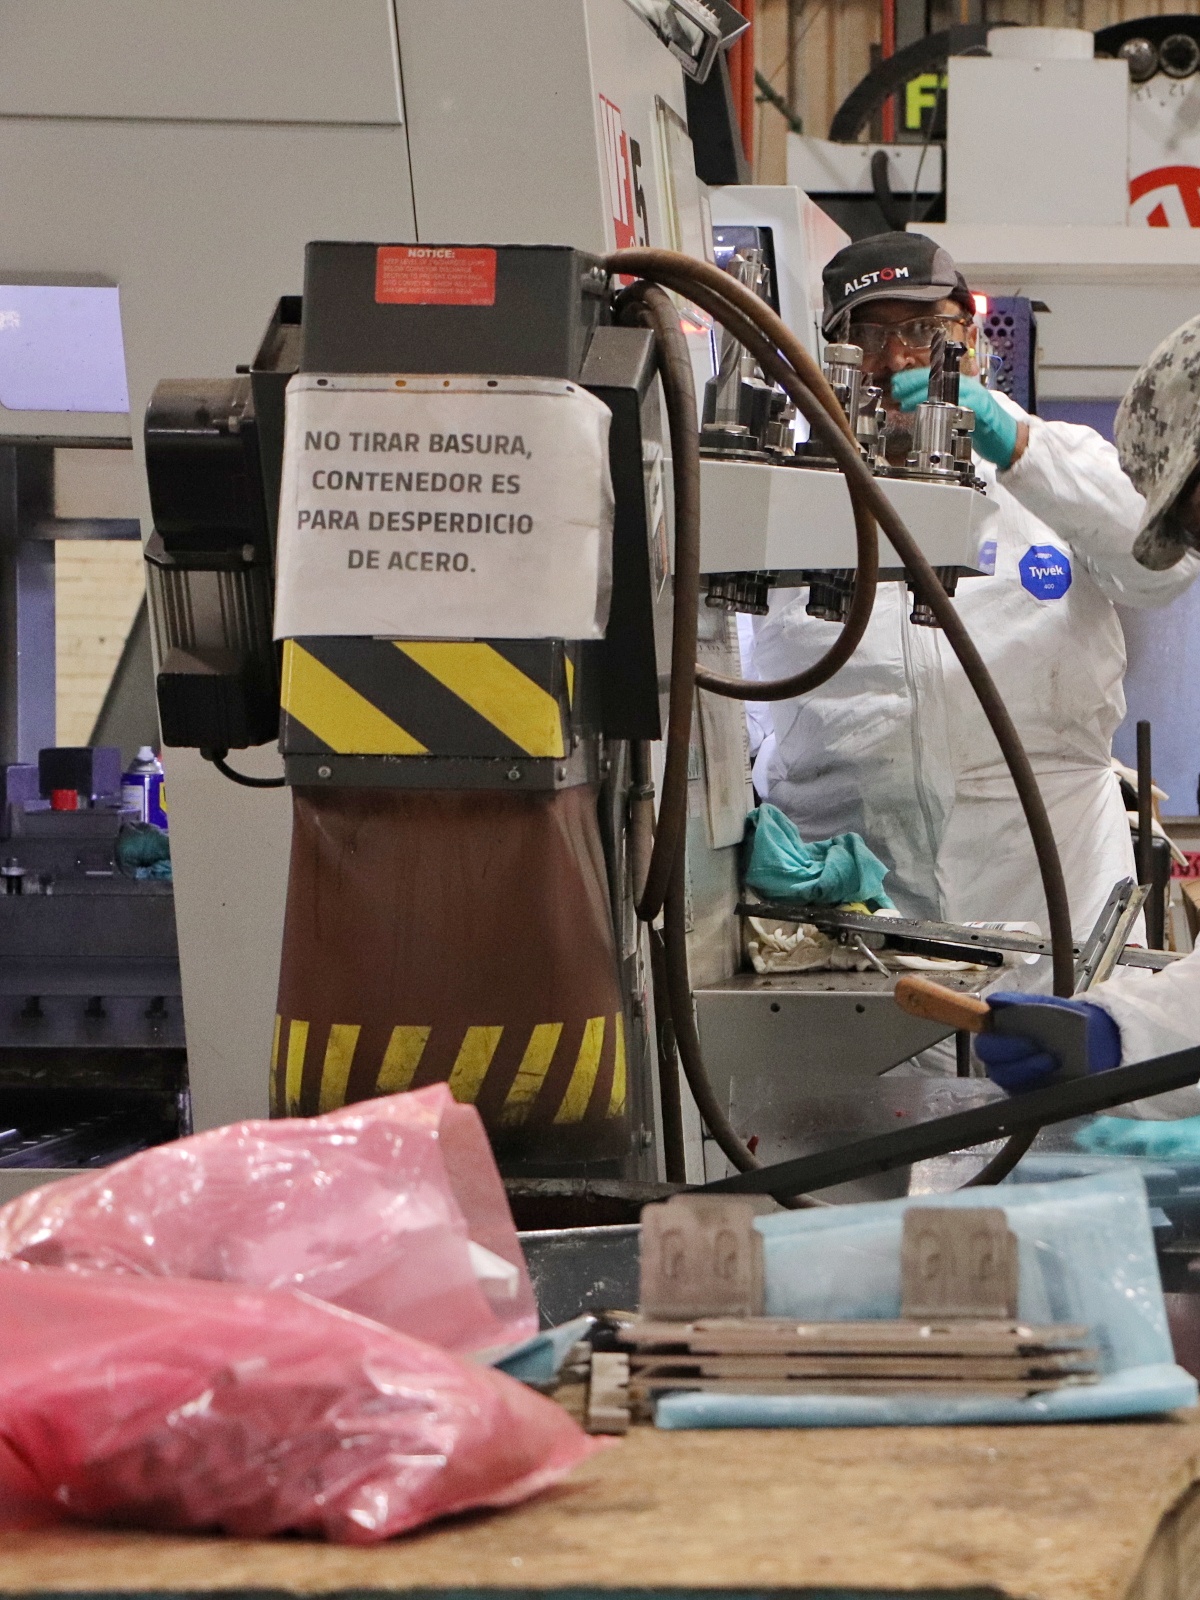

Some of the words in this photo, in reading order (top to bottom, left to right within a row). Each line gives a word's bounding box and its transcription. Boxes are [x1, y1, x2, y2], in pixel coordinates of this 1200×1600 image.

[1169, 83, 1186, 98] 12
[408, 249, 455, 259] NOTICE:
[844, 266, 909, 296] ALSTOM
[304, 430, 341, 451] NO
[349, 432, 420, 453] TIRAR
[428, 433, 533, 460] BASURA,
[312, 469, 482, 494] CONTENEDOR
[492, 474, 520, 495] ES
[297, 510, 360, 531] PARA
[369, 511, 534, 534] DESPERDICIO
[348, 549, 380, 570] DE
[387, 551, 476, 573] ACERO.
[1029, 565, 1064, 580] Tyvek
